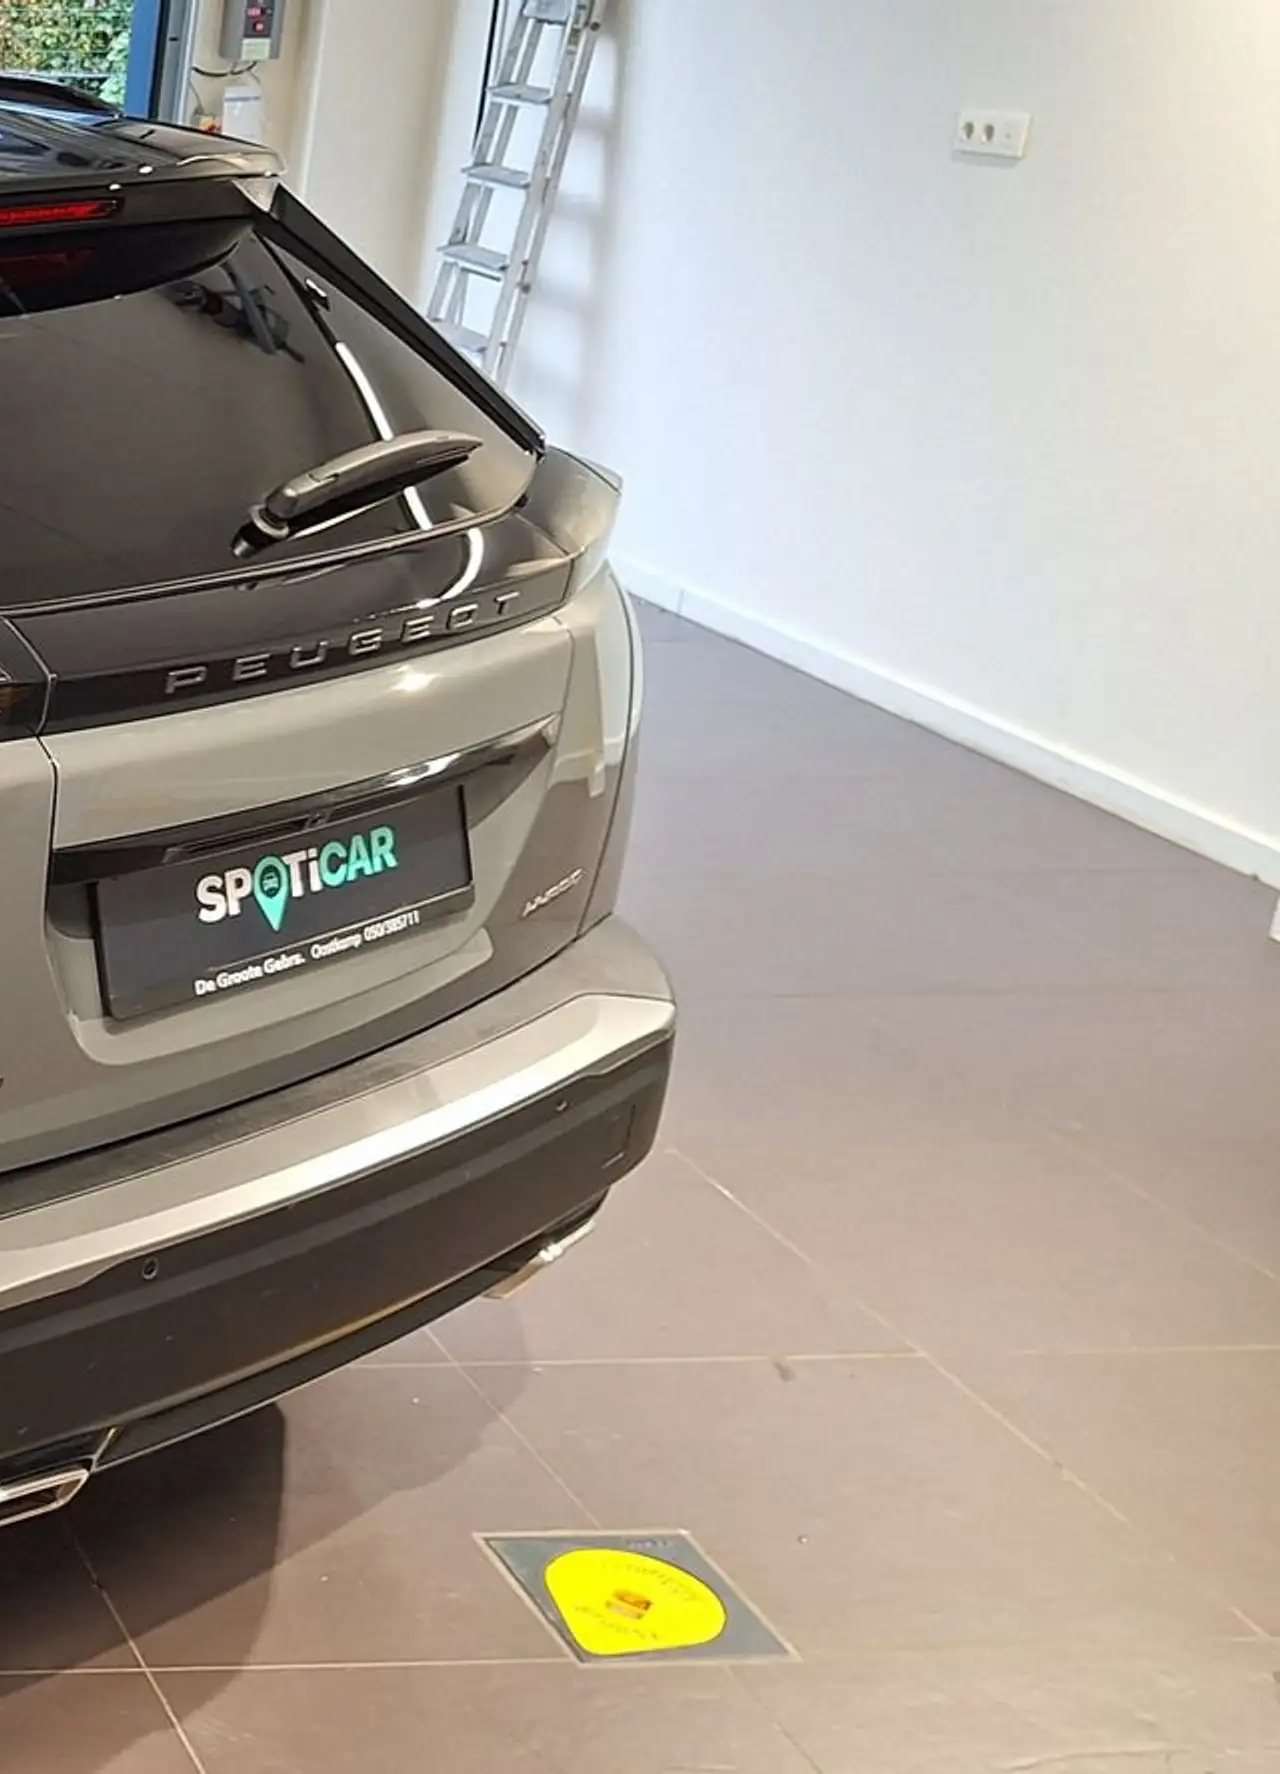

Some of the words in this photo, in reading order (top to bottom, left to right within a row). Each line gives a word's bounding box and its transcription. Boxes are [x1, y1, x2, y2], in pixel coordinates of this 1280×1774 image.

[165, 591, 520, 694] PEUGEOT
[195, 978, 216, 996] De
[216, 965, 263, 989] Groote
